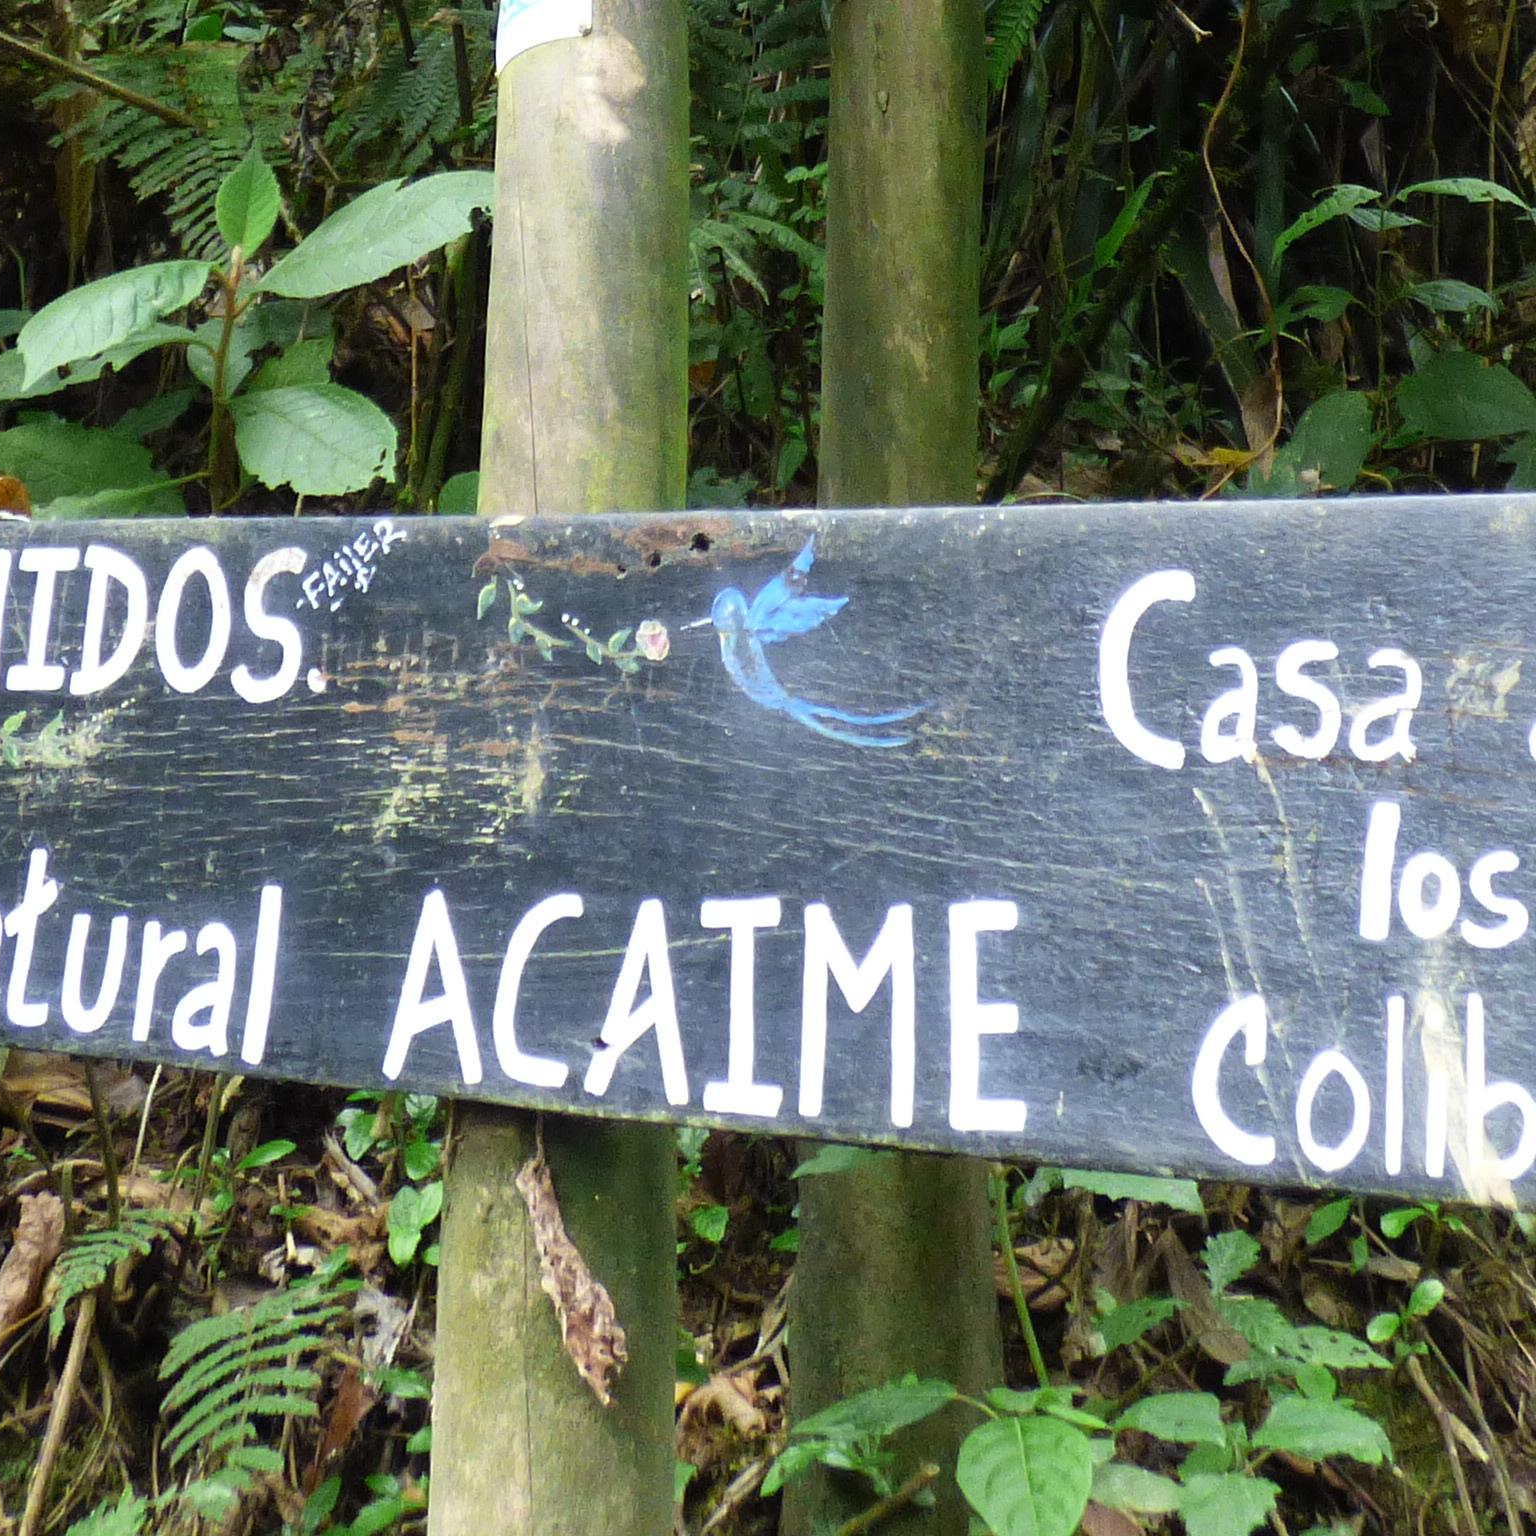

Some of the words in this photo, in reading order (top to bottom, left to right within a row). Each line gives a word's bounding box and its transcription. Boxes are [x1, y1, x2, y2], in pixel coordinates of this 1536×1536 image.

[1098, 569, 1423, 770] Casa
[1359, 801, 1530, 950] los
[382, 889, 1028, 1132] ACAIME
